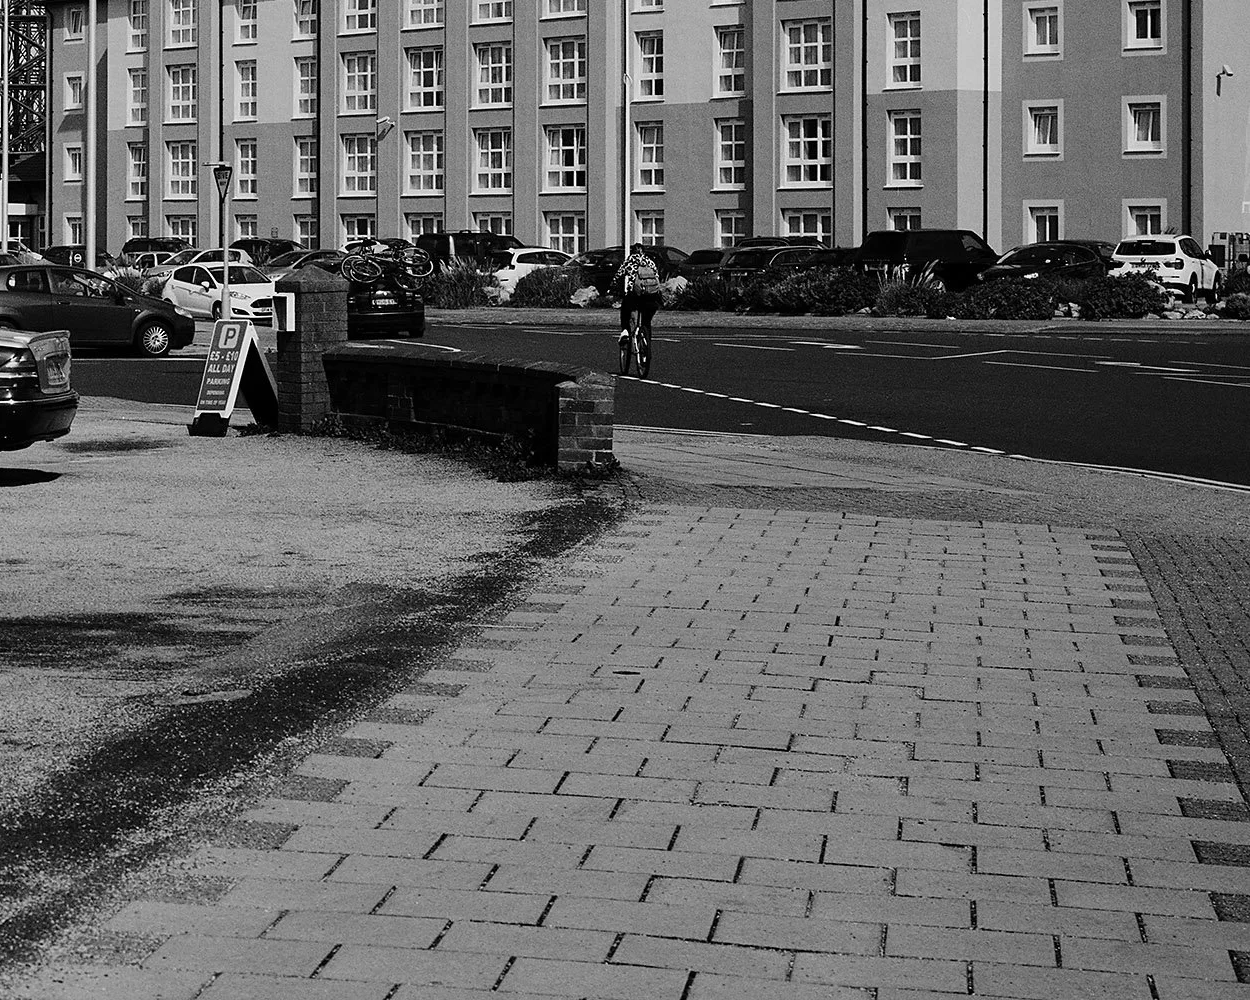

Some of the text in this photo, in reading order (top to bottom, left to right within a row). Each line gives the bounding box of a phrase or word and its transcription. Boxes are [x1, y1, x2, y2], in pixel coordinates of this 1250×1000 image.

[224, 328, 236, 346] P
[210, 351, 220, 361] £5
[225, 351, 239, 361] £10
[207, 364, 235, 373] ALL DAY
